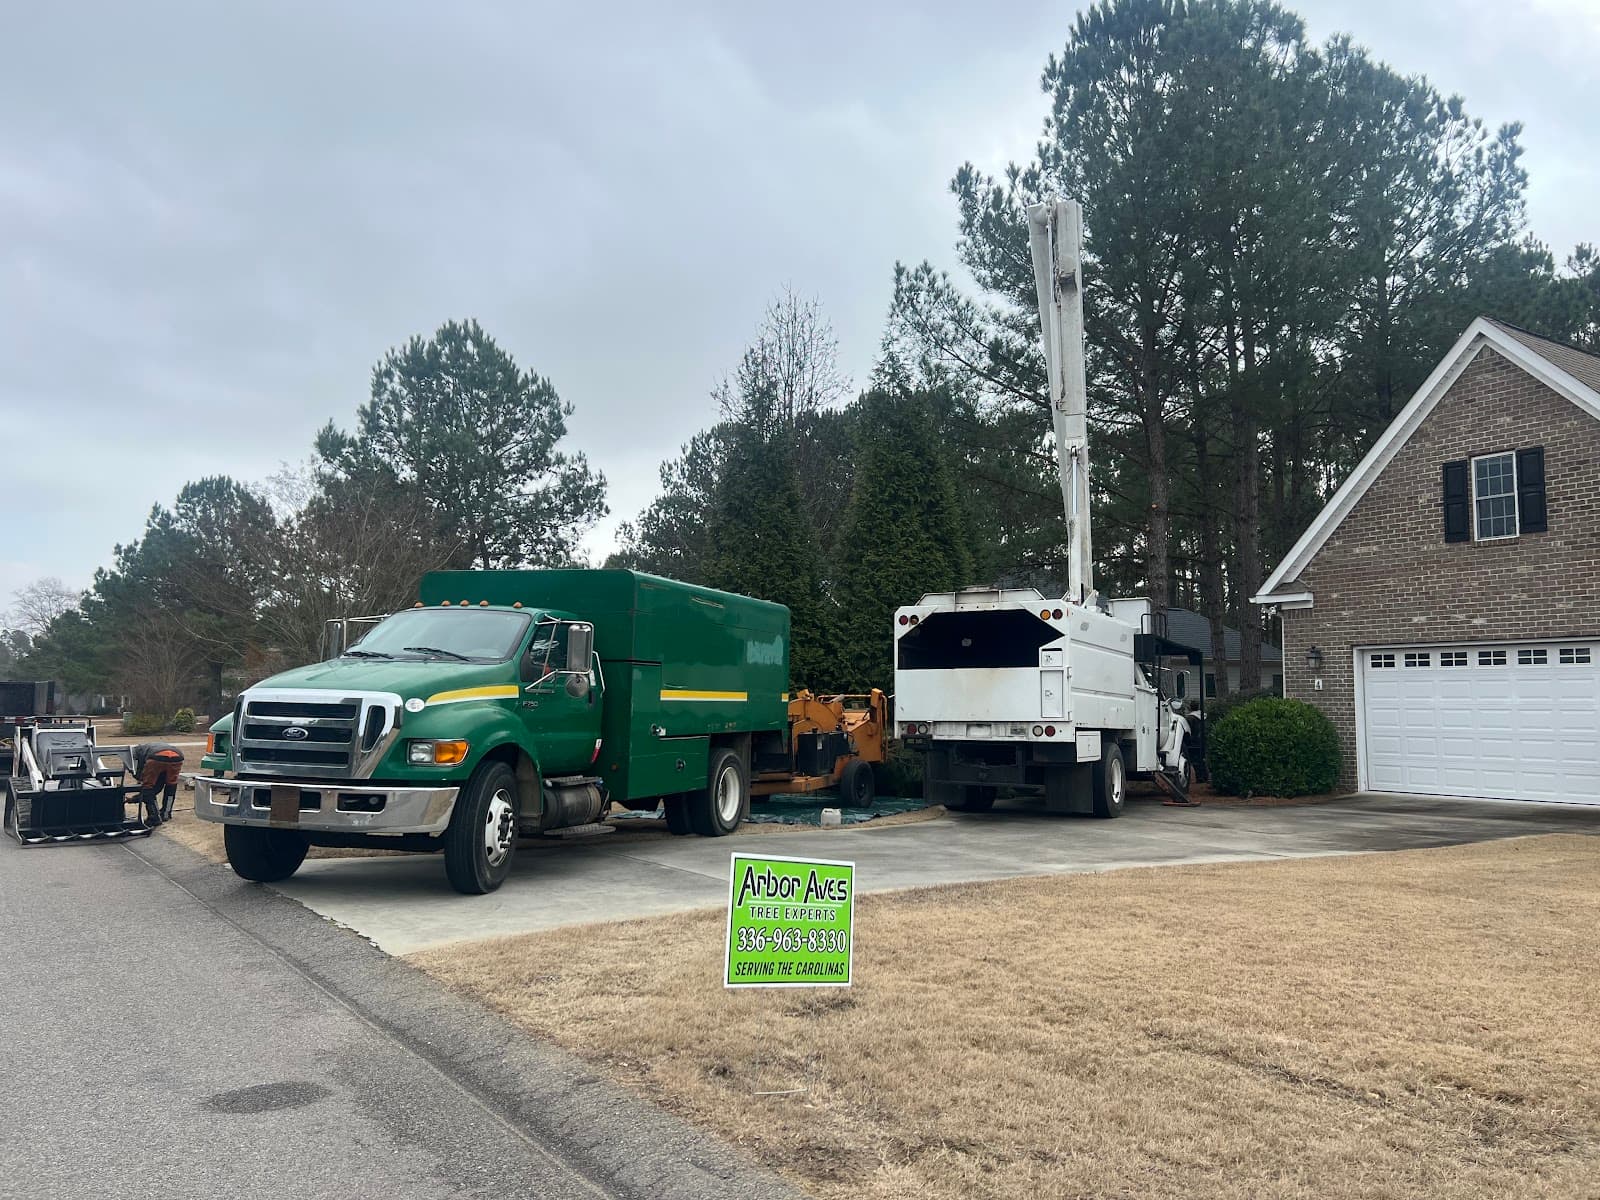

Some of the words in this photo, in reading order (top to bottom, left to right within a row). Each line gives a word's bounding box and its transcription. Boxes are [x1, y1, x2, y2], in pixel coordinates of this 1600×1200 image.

[737, 865, 800, 906] Arbor
[803, 870, 847, 904] Aves
[750, 906, 779, 919] TREE
[785, 907, 836, 921] EXPERTS
[737, 926, 846, 953] 336-963-8330
[735, 962, 775, 976] SERVING
[777, 961, 794, 975] THE
[795, 961, 845, 976] CAROLINAS
